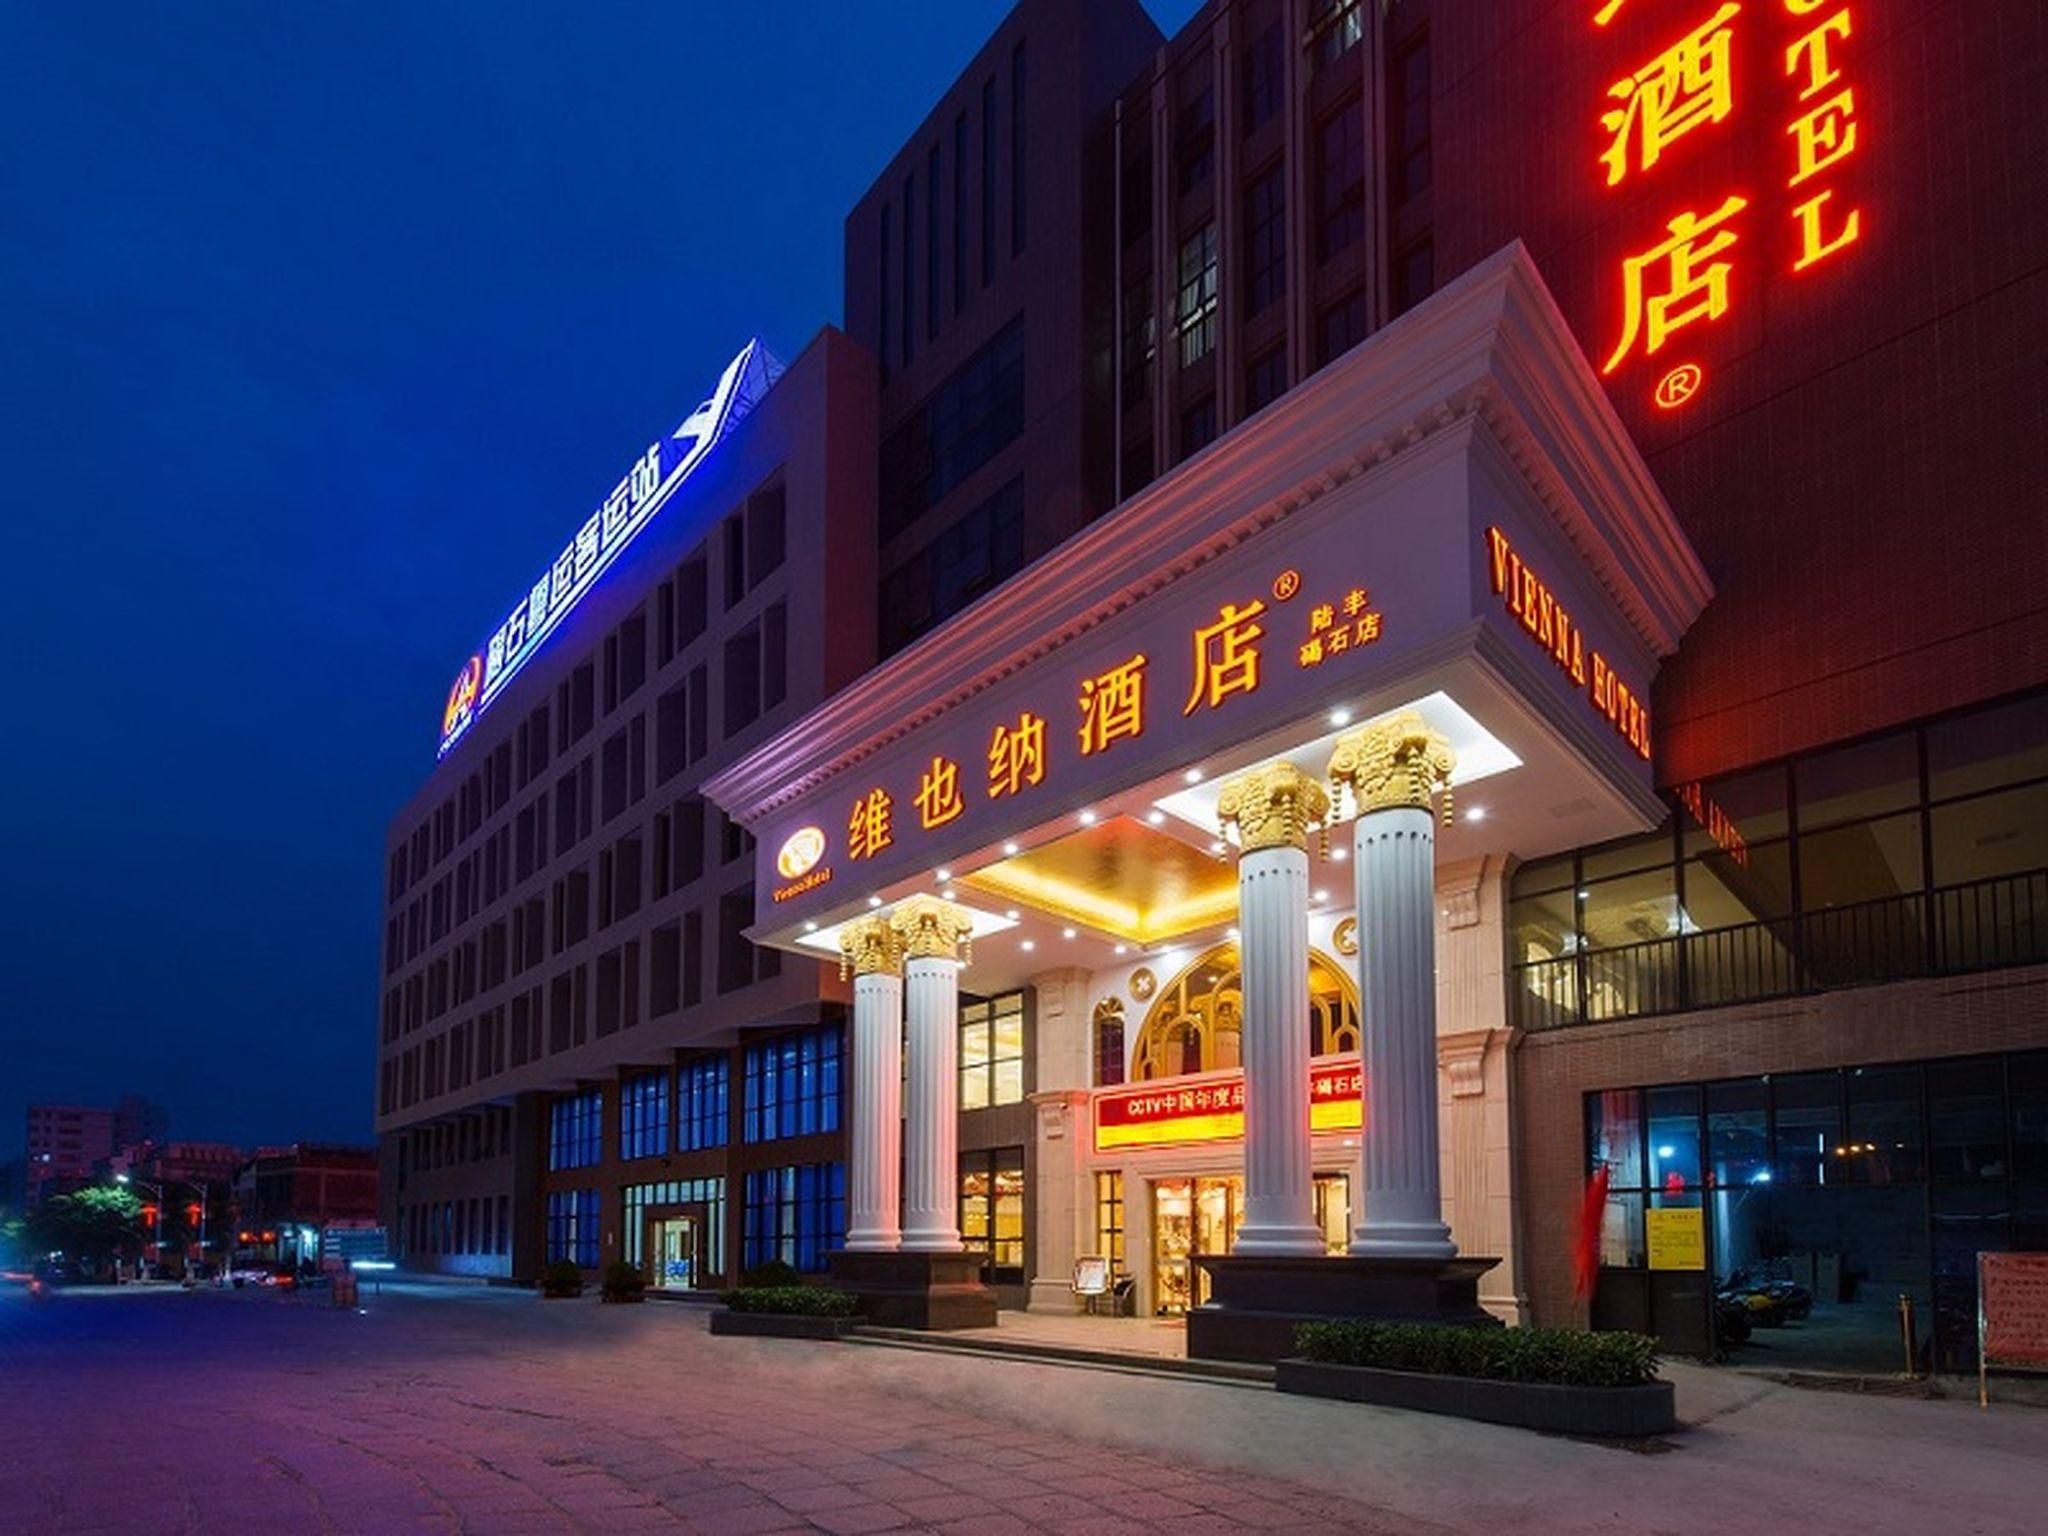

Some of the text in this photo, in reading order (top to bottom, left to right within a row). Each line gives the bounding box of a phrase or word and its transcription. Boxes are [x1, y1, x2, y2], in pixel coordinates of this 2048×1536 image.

[1594, 0, 1748, 374] 酒店
[1783, 0, 1860, 272] TEL
[847, 598, 1268, 862] 维也纳酒店
[1486, 525, 1651, 760] VIENNA HOTEL
